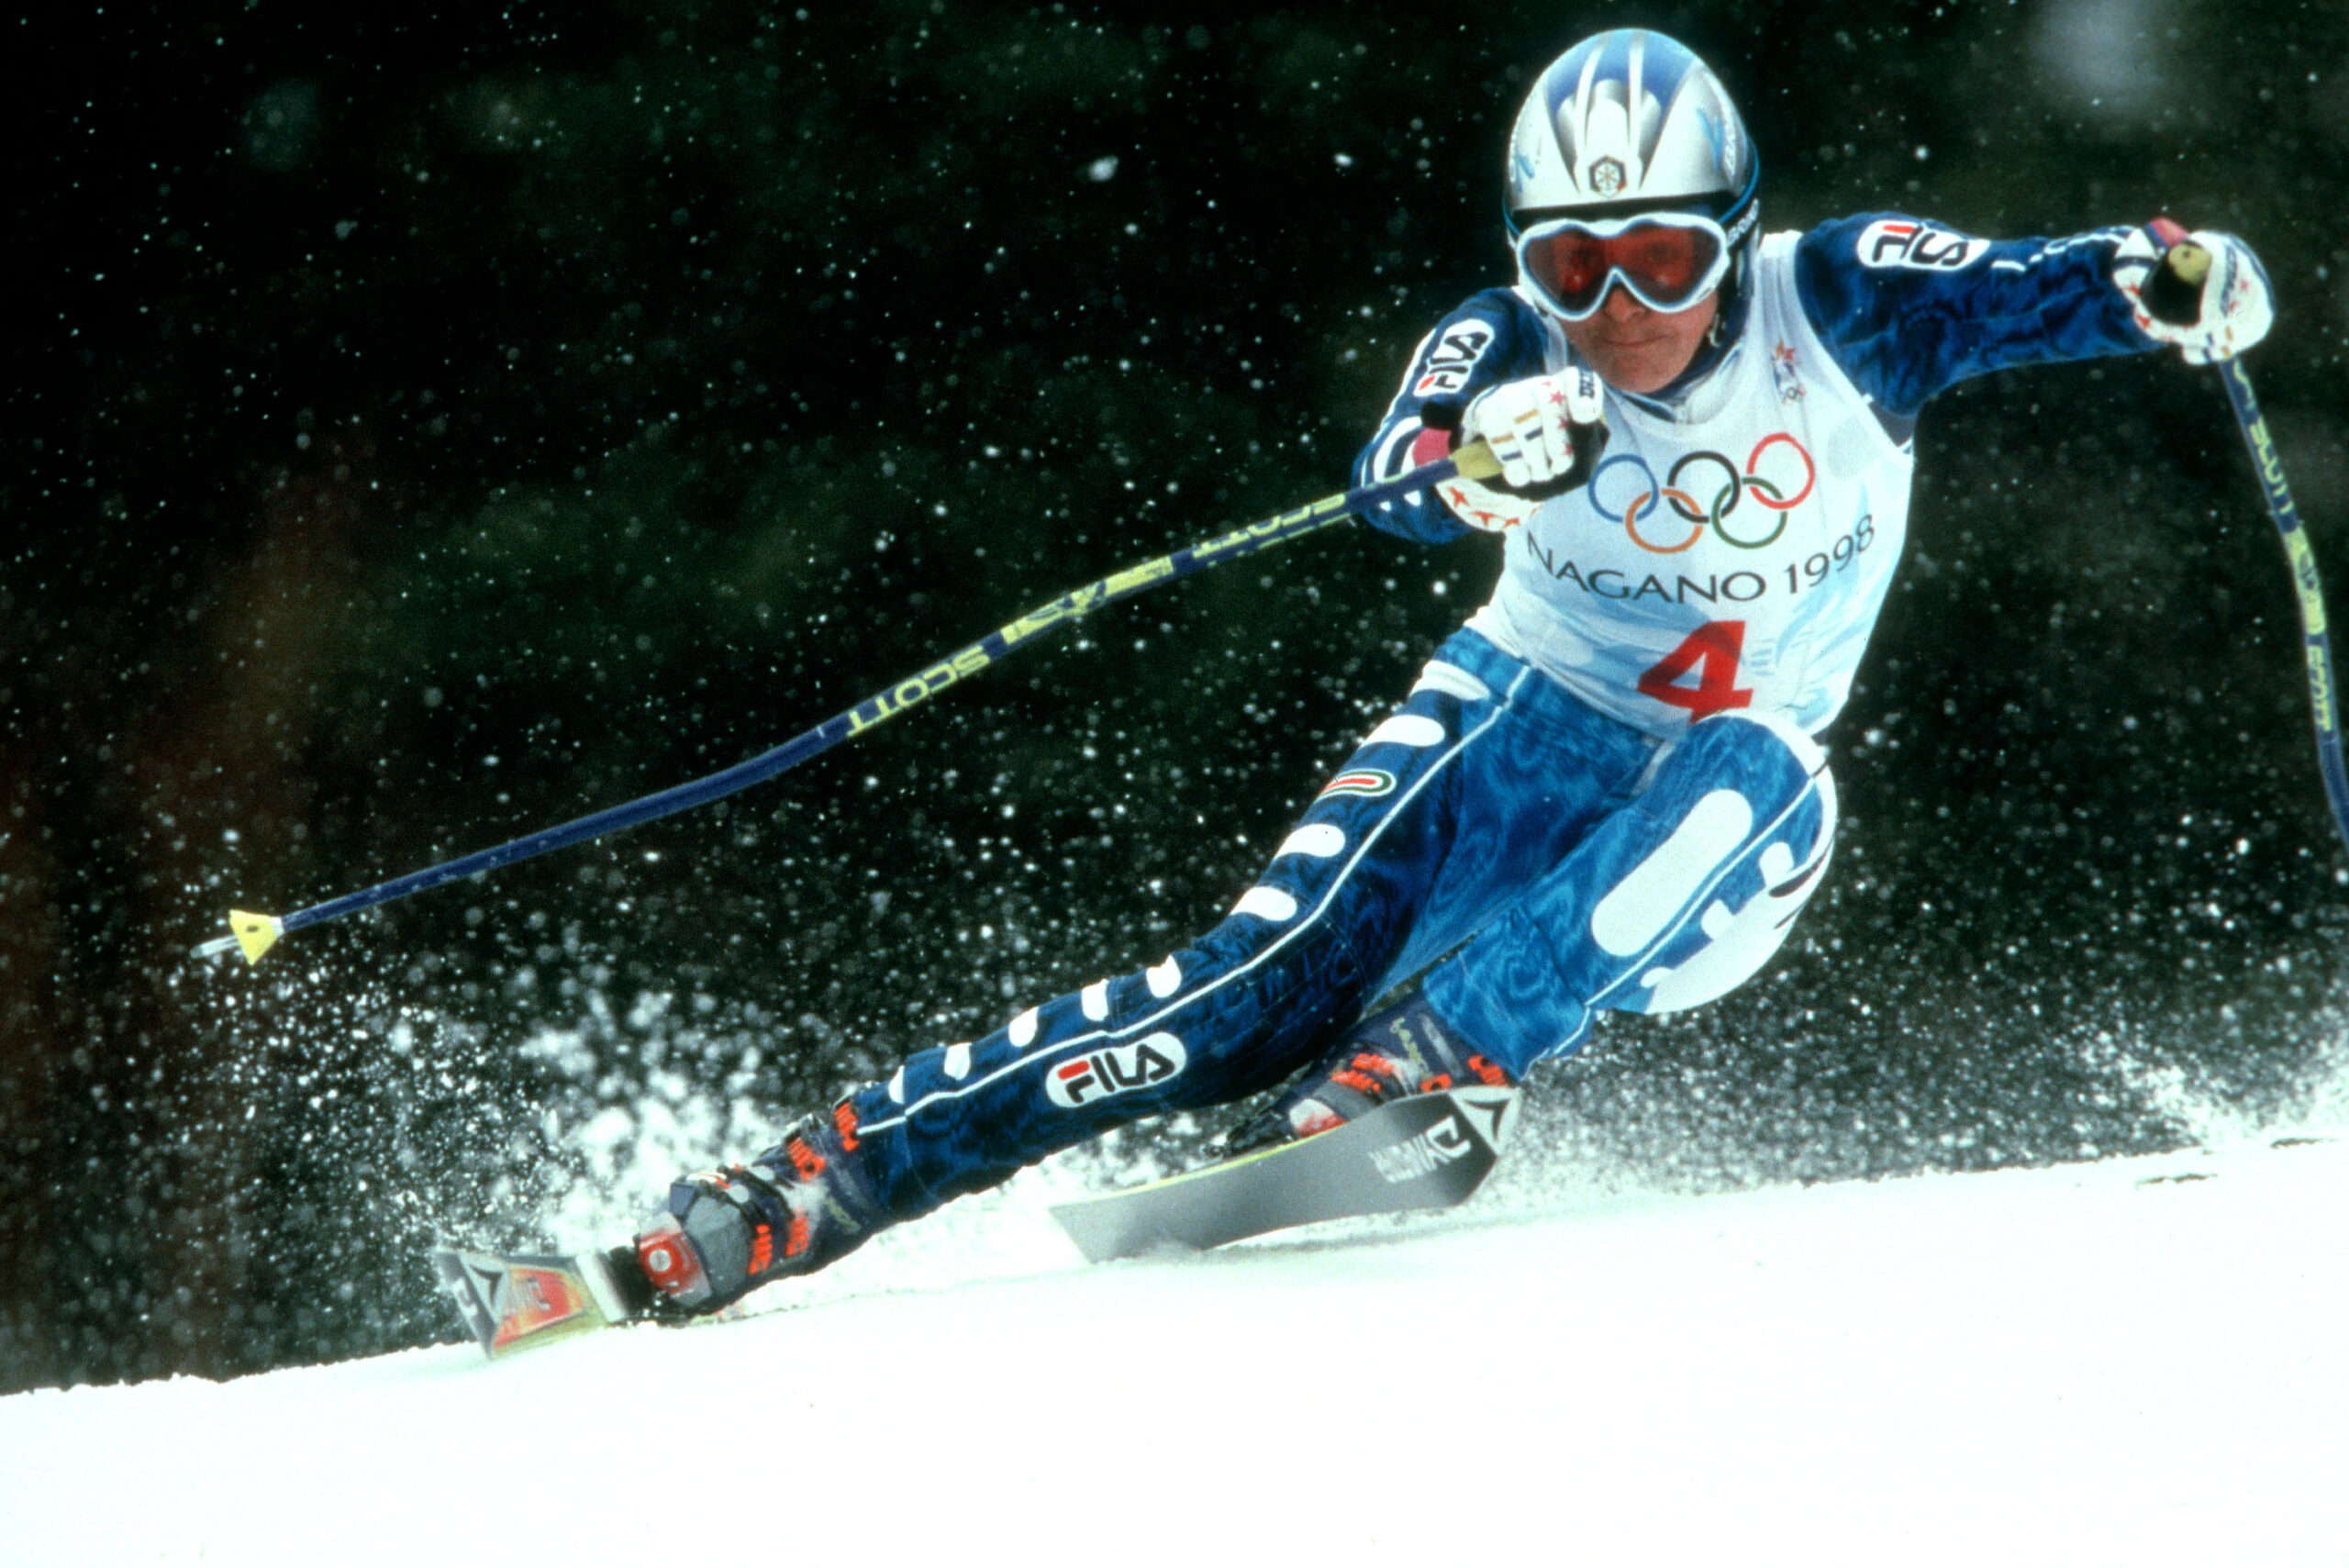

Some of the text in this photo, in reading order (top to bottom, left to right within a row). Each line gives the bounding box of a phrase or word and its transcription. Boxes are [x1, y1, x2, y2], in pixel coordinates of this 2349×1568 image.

[1419, 331, 1489, 391] FILA
[1527, 513, 1876, 605] NAGANO 1998
[847, 644, 992, 737] SCOTT
[1637, 619, 1754, 724] 4
[1056, 1042, 1175, 1105] FILA
